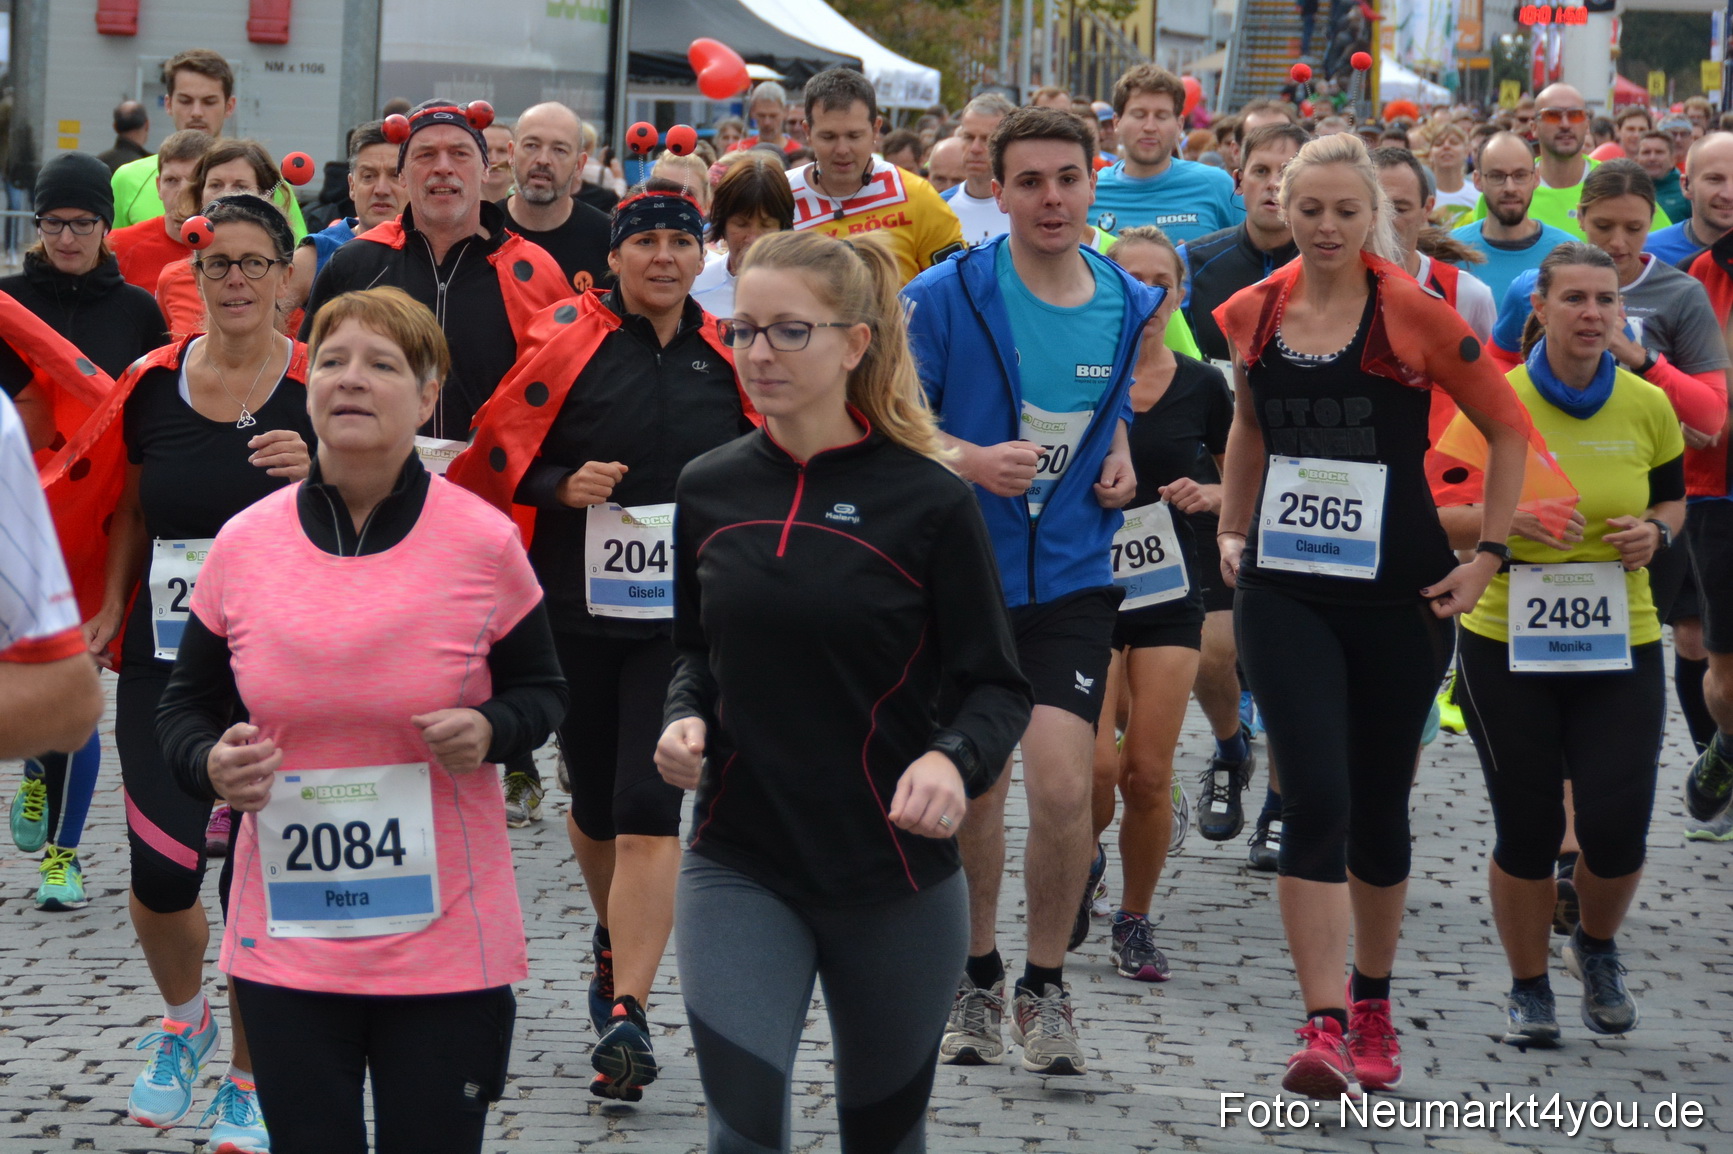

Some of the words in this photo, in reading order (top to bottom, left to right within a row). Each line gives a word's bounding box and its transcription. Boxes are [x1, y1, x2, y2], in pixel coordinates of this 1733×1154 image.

[265, 61, 284, 71] NM
[300, 63, 325, 73] 1106
[848, 212, 913, 235] BÖGL
[1156, 213, 1199, 225] BOCK
[1075, 364, 1112, 378] BOC
[1265, 397, 1373, 427] STOP
[1031, 418, 1068, 431] BOCK
[1308, 469, 1349, 482] BOCK
[1278, 491, 1363, 533] 2565
[604, 538, 675, 574] 204
[1296, 539, 1340, 556] Claudia
[1554, 573, 1595, 583] BOCK
[168, 577, 196, 613] 2
[628, 586, 665, 599] Gisela
[1527, 596, 1612, 629] 2484
[1549, 640, 1593, 653] Monika
[317, 783, 378, 800] BOCK
[282, 817, 407, 872] 2084
[271, 865, 276, 875] D
[325, 889, 370, 907] Petra
